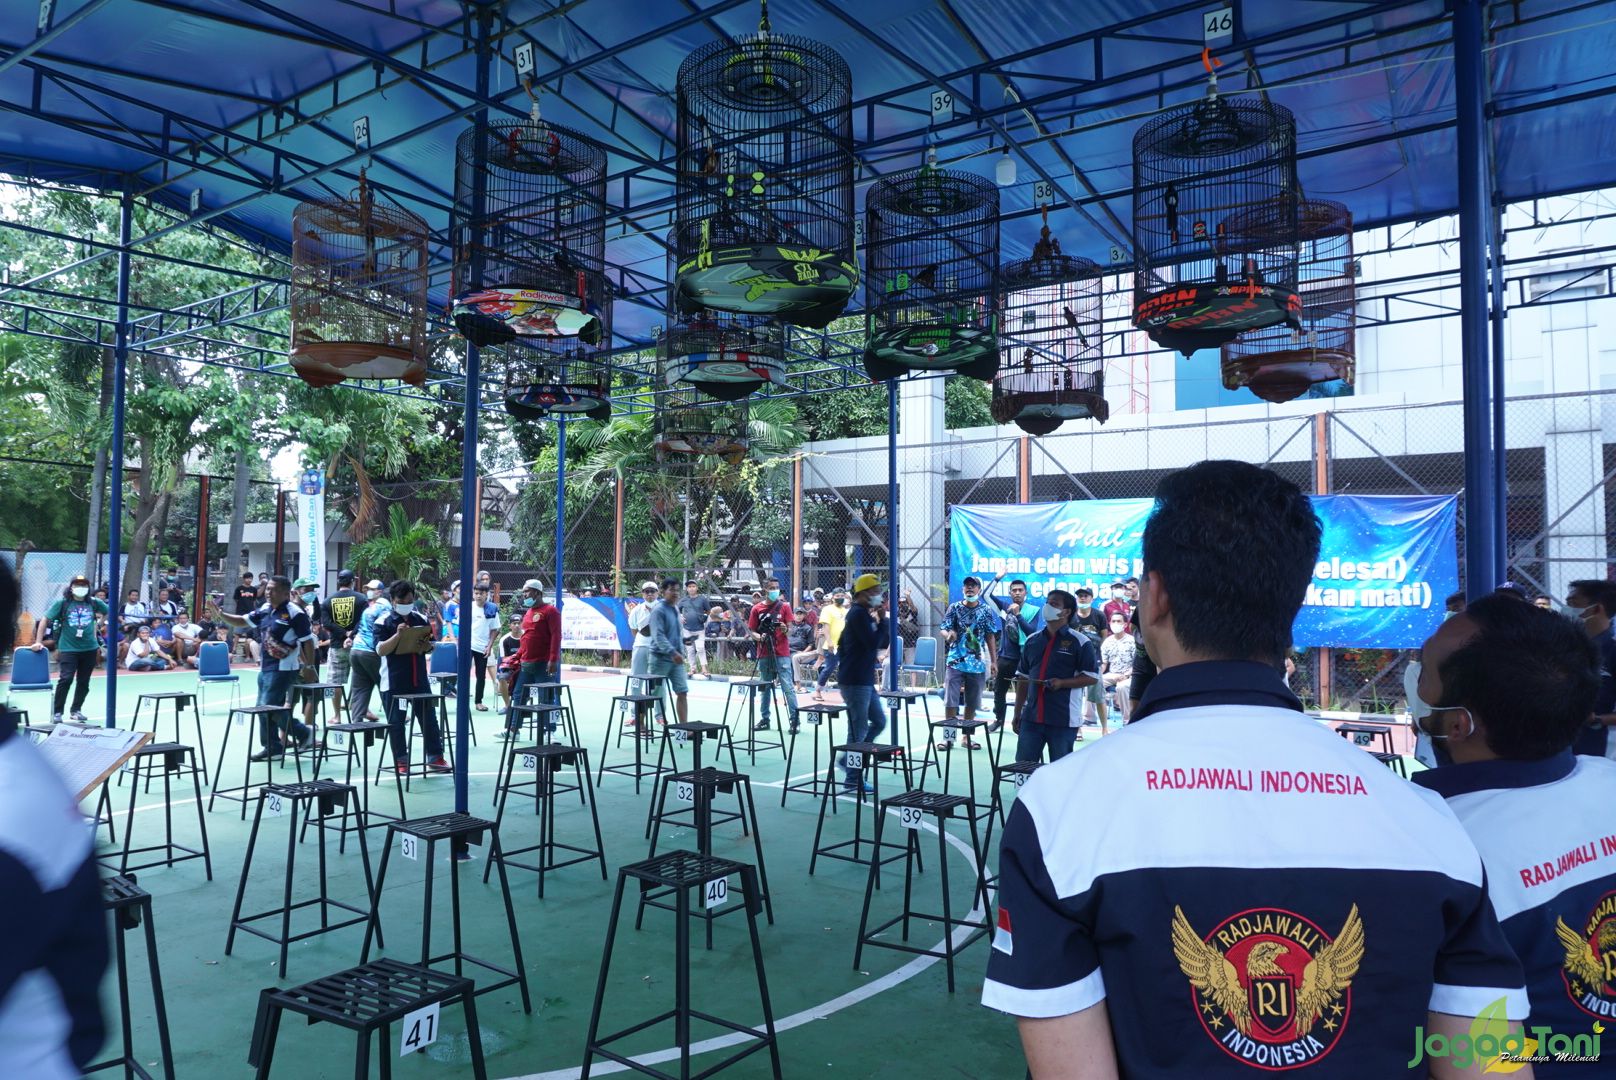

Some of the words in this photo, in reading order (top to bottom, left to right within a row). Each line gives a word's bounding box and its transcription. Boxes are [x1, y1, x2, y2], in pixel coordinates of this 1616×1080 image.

[1207, 13, 1232, 33] 46
[518, 49, 531, 68] 31
[934, 94, 952, 111] 39
[355, 123, 367, 140] 26
[722, 155, 736, 170] 32
[1036, 184, 1052, 198] 38
[1054, 517, 1126, 548] Hati
[308, 540, 318, 582] ogether
[971, 554, 1031, 574] Jaman
[1034, 553, 1086, 574] edan
[1089, 554, 1129, 575] wis
[1313, 556, 1407, 583] elesai)
[1360, 582, 1432, 609] mati)
[887, 697, 897, 707] 22
[807, 712, 819, 722] 23
[675, 730, 687, 741] 24
[944, 729, 956, 740] 34
[1355, 735, 1370, 746] 49
[523, 755, 535, 768] 25
[848, 754, 861, 767] 33
[1146, 768, 1253, 792] RADJAWALI
[1260, 770, 1368, 796] INDONESIA
[678, 785, 693, 801] 32
[269, 795, 281, 812] 26
[902, 808, 921, 824] 39
[403, 838, 415, 857] 31
[1519, 841, 1598, 889] RADJAWALI
[707, 879, 726, 901] 40
[1217, 914, 1319, 950] RADJAWALI
[1255, 981, 1288, 1017] RI
[406, 1014, 433, 1047] 41
[1222, 1028, 1324, 1067] INDONESIA
